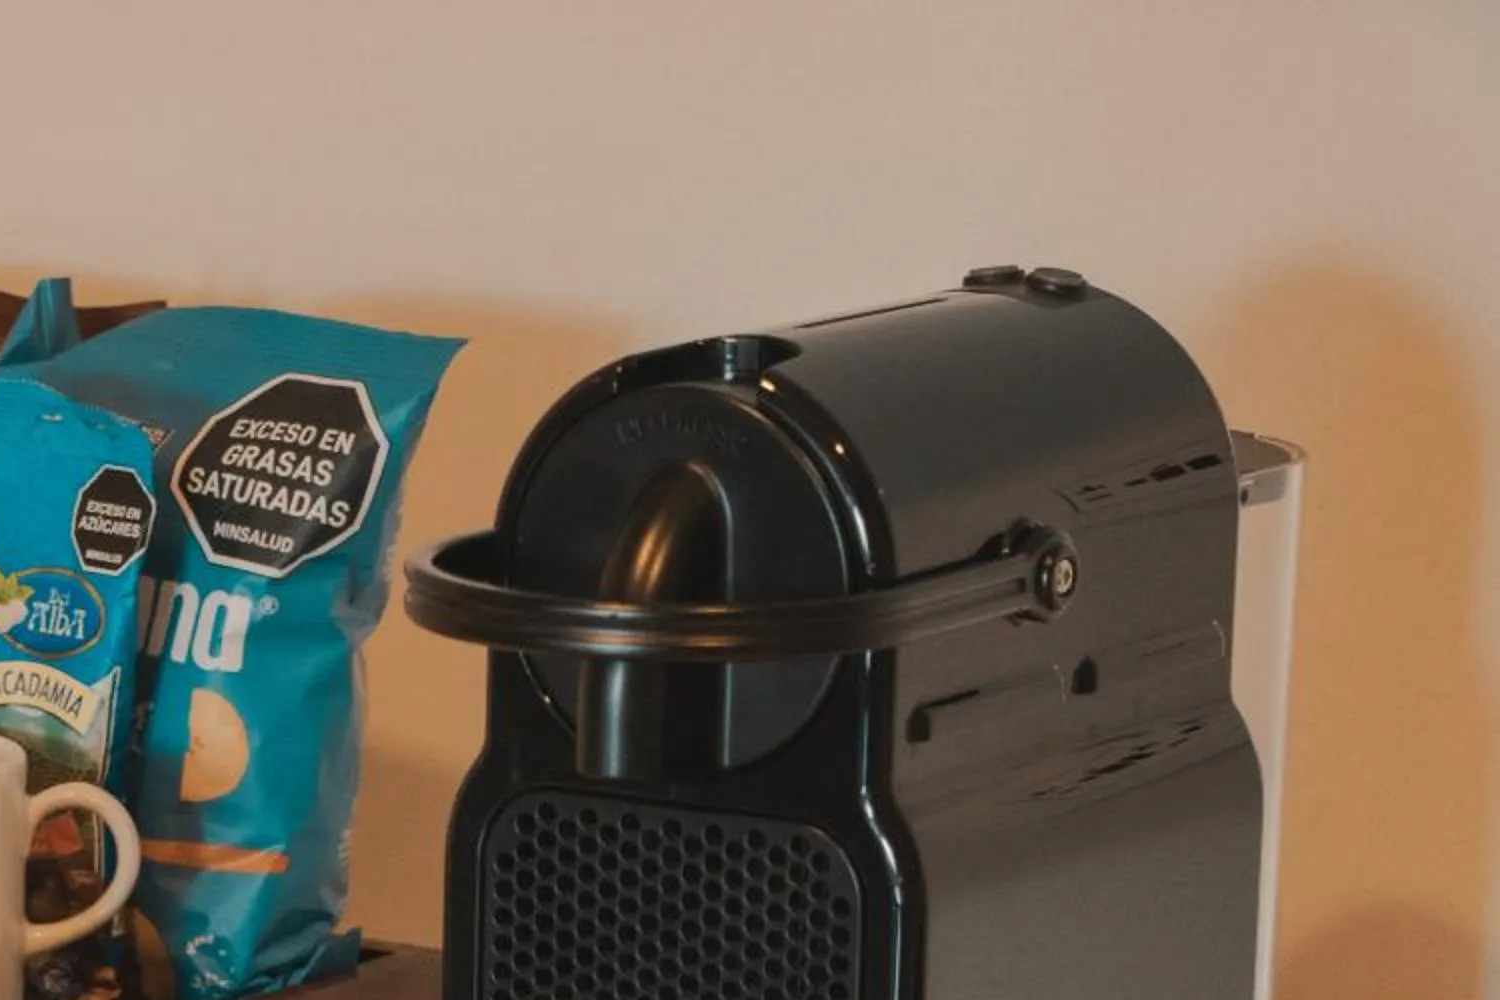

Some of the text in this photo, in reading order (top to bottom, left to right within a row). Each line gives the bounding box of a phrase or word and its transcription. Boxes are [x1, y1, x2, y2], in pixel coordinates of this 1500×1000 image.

[229, 418, 356, 455] EXCESO EN
[221, 444, 335, 487] GRASAS
[186, 466, 350, 529] SATURADAS
[212, 519, 295, 553] MINSALUD
